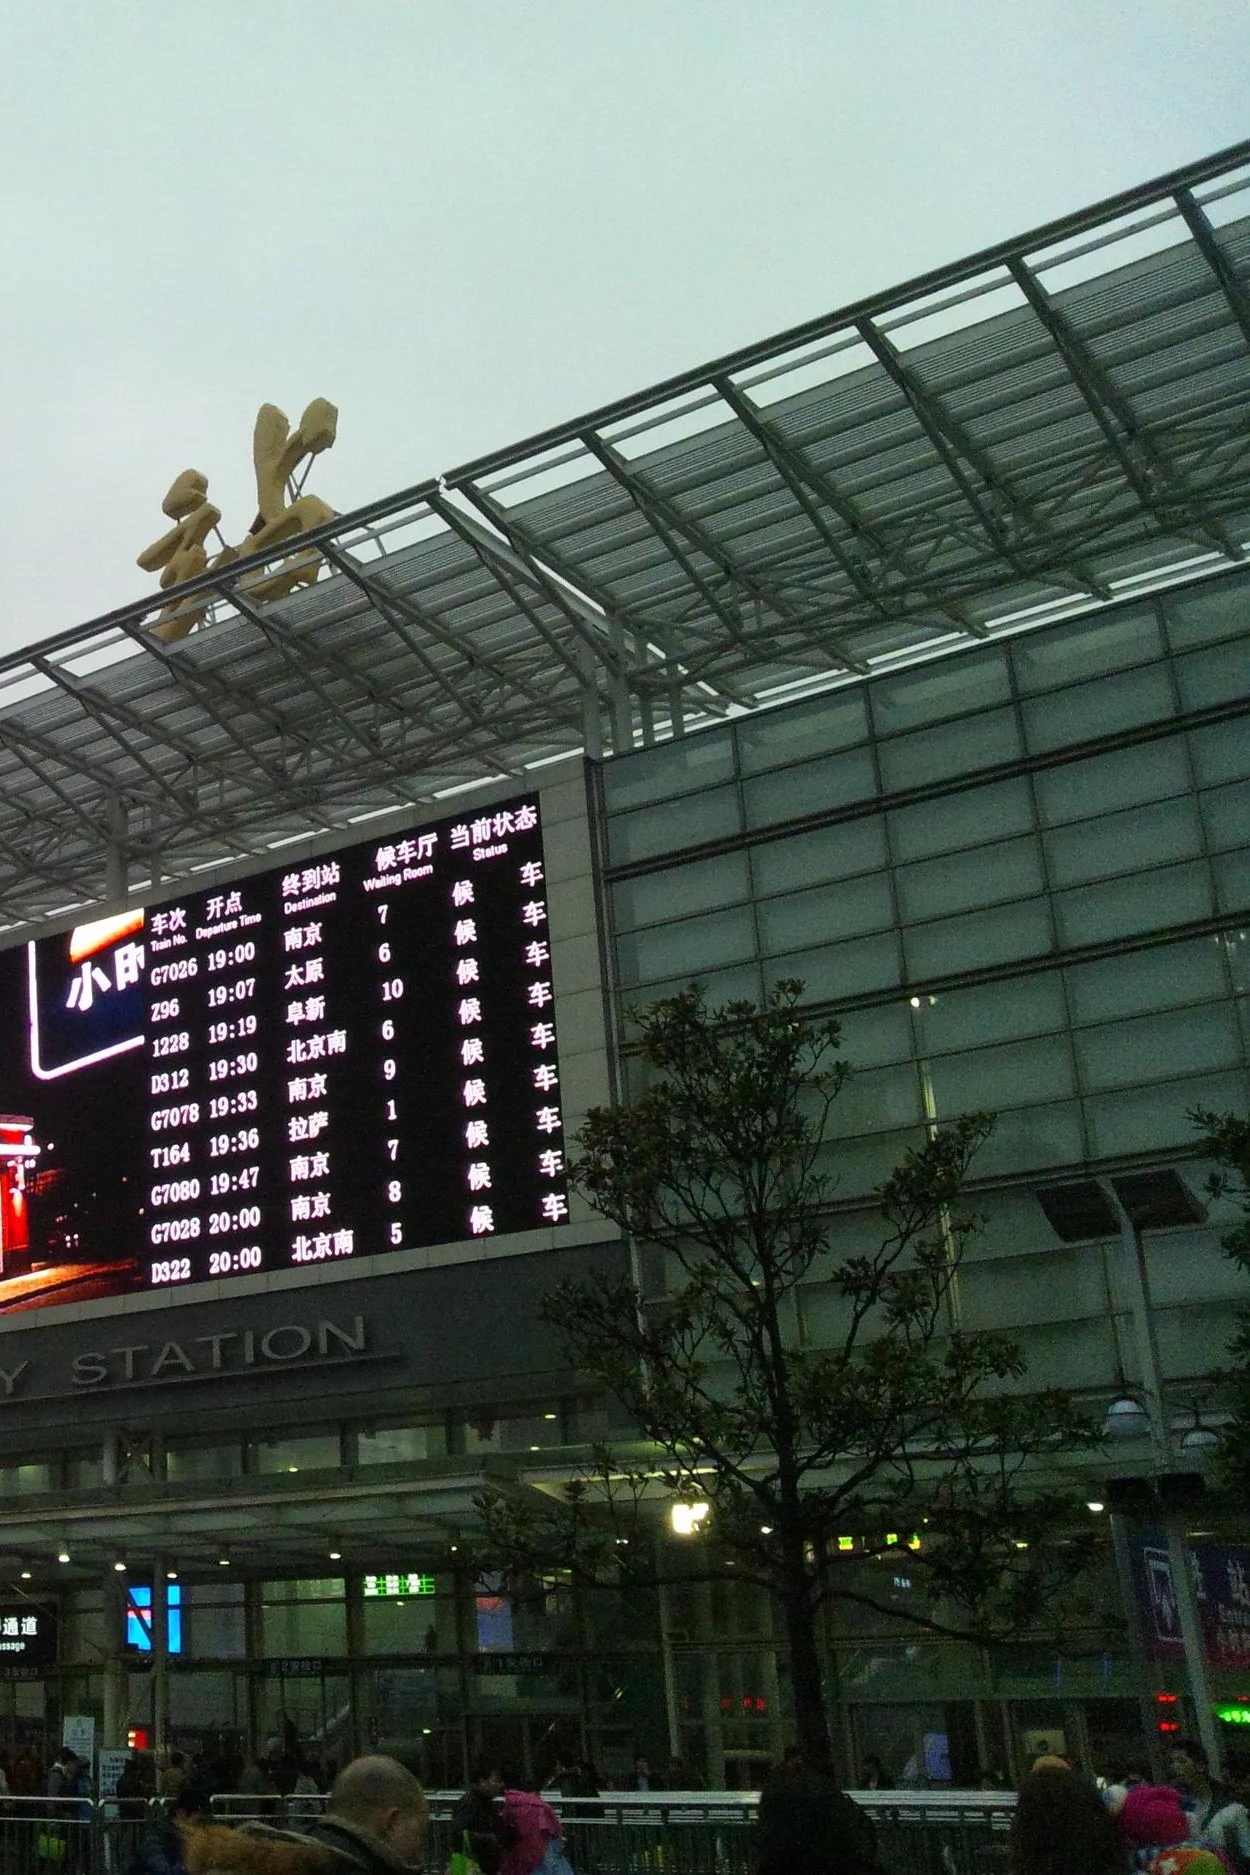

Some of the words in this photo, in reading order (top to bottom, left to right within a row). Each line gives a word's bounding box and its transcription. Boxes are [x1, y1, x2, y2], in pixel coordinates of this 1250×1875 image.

[151, 907, 186, 935] 车次
[206, 891, 242, 920] 开点
[282, 861, 340, 897] 终到站
[375, 832, 438, 872] 候车厅
[450, 805, 537, 849] 当前状态
[151, 938, 171, 952] Train
[173, 934, 188, 946] No.
[196, 920, 237, 940] Departure
[239, 913, 262, 928] Time
[284, 892, 336, 914] Destination
[364, 870, 401, 892] Waiting
[403, 863, 433, 883] Room
[473, 844, 508, 861] Status
[151, 958, 198, 986] G7026
[208, 942, 255, 971] 19:00
[284, 922, 322, 951] 南京
[378, 905, 388, 924] 7
[151, 998, 179, 1022] Z96
[208, 978, 255, 1007] 19:07
[285, 957, 324, 990] 太原
[379, 943, 391, 962] 6
[153, 1032, 189, 1057] 1228
[209, 1015, 256, 1044] 19:19
[285, 995, 325, 1025] 阜新
[382, 979, 403, 1001] 10
[151, 1068, 189, 1094] D312
[209, 1052, 257, 1081] 19:30
[287, 1030, 346, 1064] 北京南
[382, 1020, 394, 1040] 6
[151, 1103, 199, 1131] G7078
[210, 1090, 257, 1119] 19:33
[287, 1073, 327, 1103] 南京
[384, 1059, 396, 1080] 9
[150, 1142, 190, 1168] T164
[210, 1128, 259, 1157] 19:36
[288, 1111, 328, 1142] 拉萨
[387, 1100, 397, 1120] 1
[151, 1179, 200, 1206] G7080
[211, 1166, 259, 1195] 19:47
[289, 1151, 330, 1182] 南京
[388, 1139, 399, 1161] 7
[151, 1217, 200, 1244] G7028
[209, 1206, 260, 1234] 20:00
[291, 1192, 331, 1221] 南京
[388, 1181, 401, 1202] 8
[152, 1258, 190, 1283] D322
[209, 1246, 261, 1274] 20:00
[292, 1229, 353, 1262] 北京南
[391, 1222, 402, 1244] 5
[72, 1315, 366, 1386] STATION
